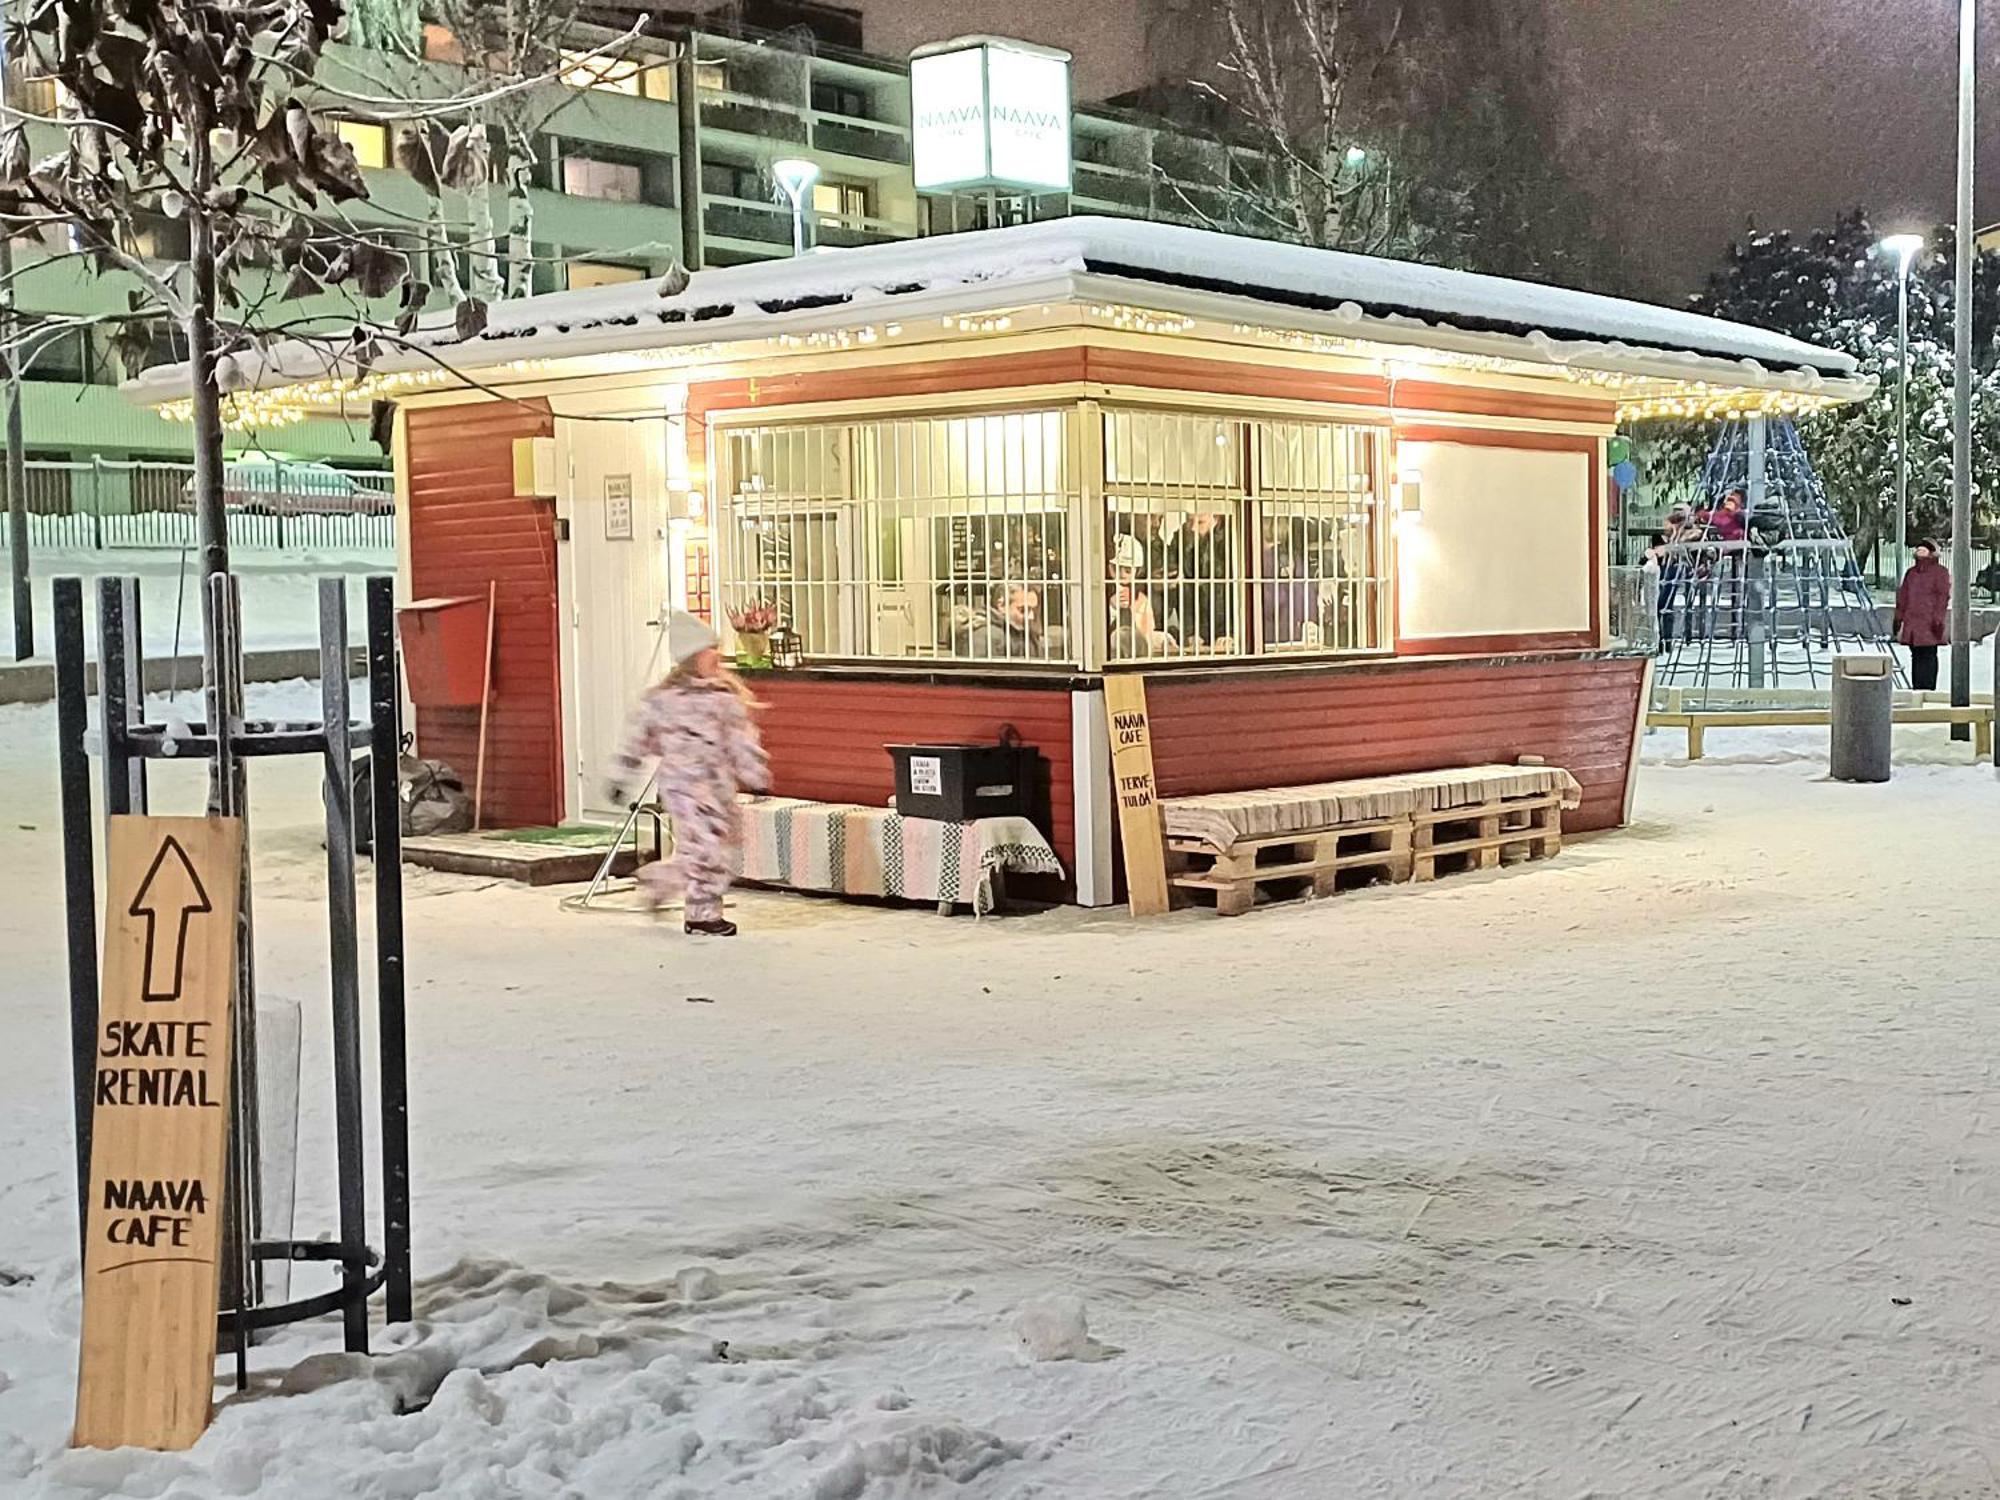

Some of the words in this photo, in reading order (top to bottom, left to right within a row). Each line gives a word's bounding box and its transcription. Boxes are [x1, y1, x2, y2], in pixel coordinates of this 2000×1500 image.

[919, 104, 981, 128] NAAVA
[992, 105, 1062, 131] NAAVA
[1114, 713, 1146, 731] NAAVA
[1120, 730, 1143, 745] CAFE
[100, 1021, 212, 1057] SKATE
[97, 1068, 220, 1107] RENTAL
[104, 1179, 208, 1214] NAAVA
[107, 1214, 192, 1248] CAFE
